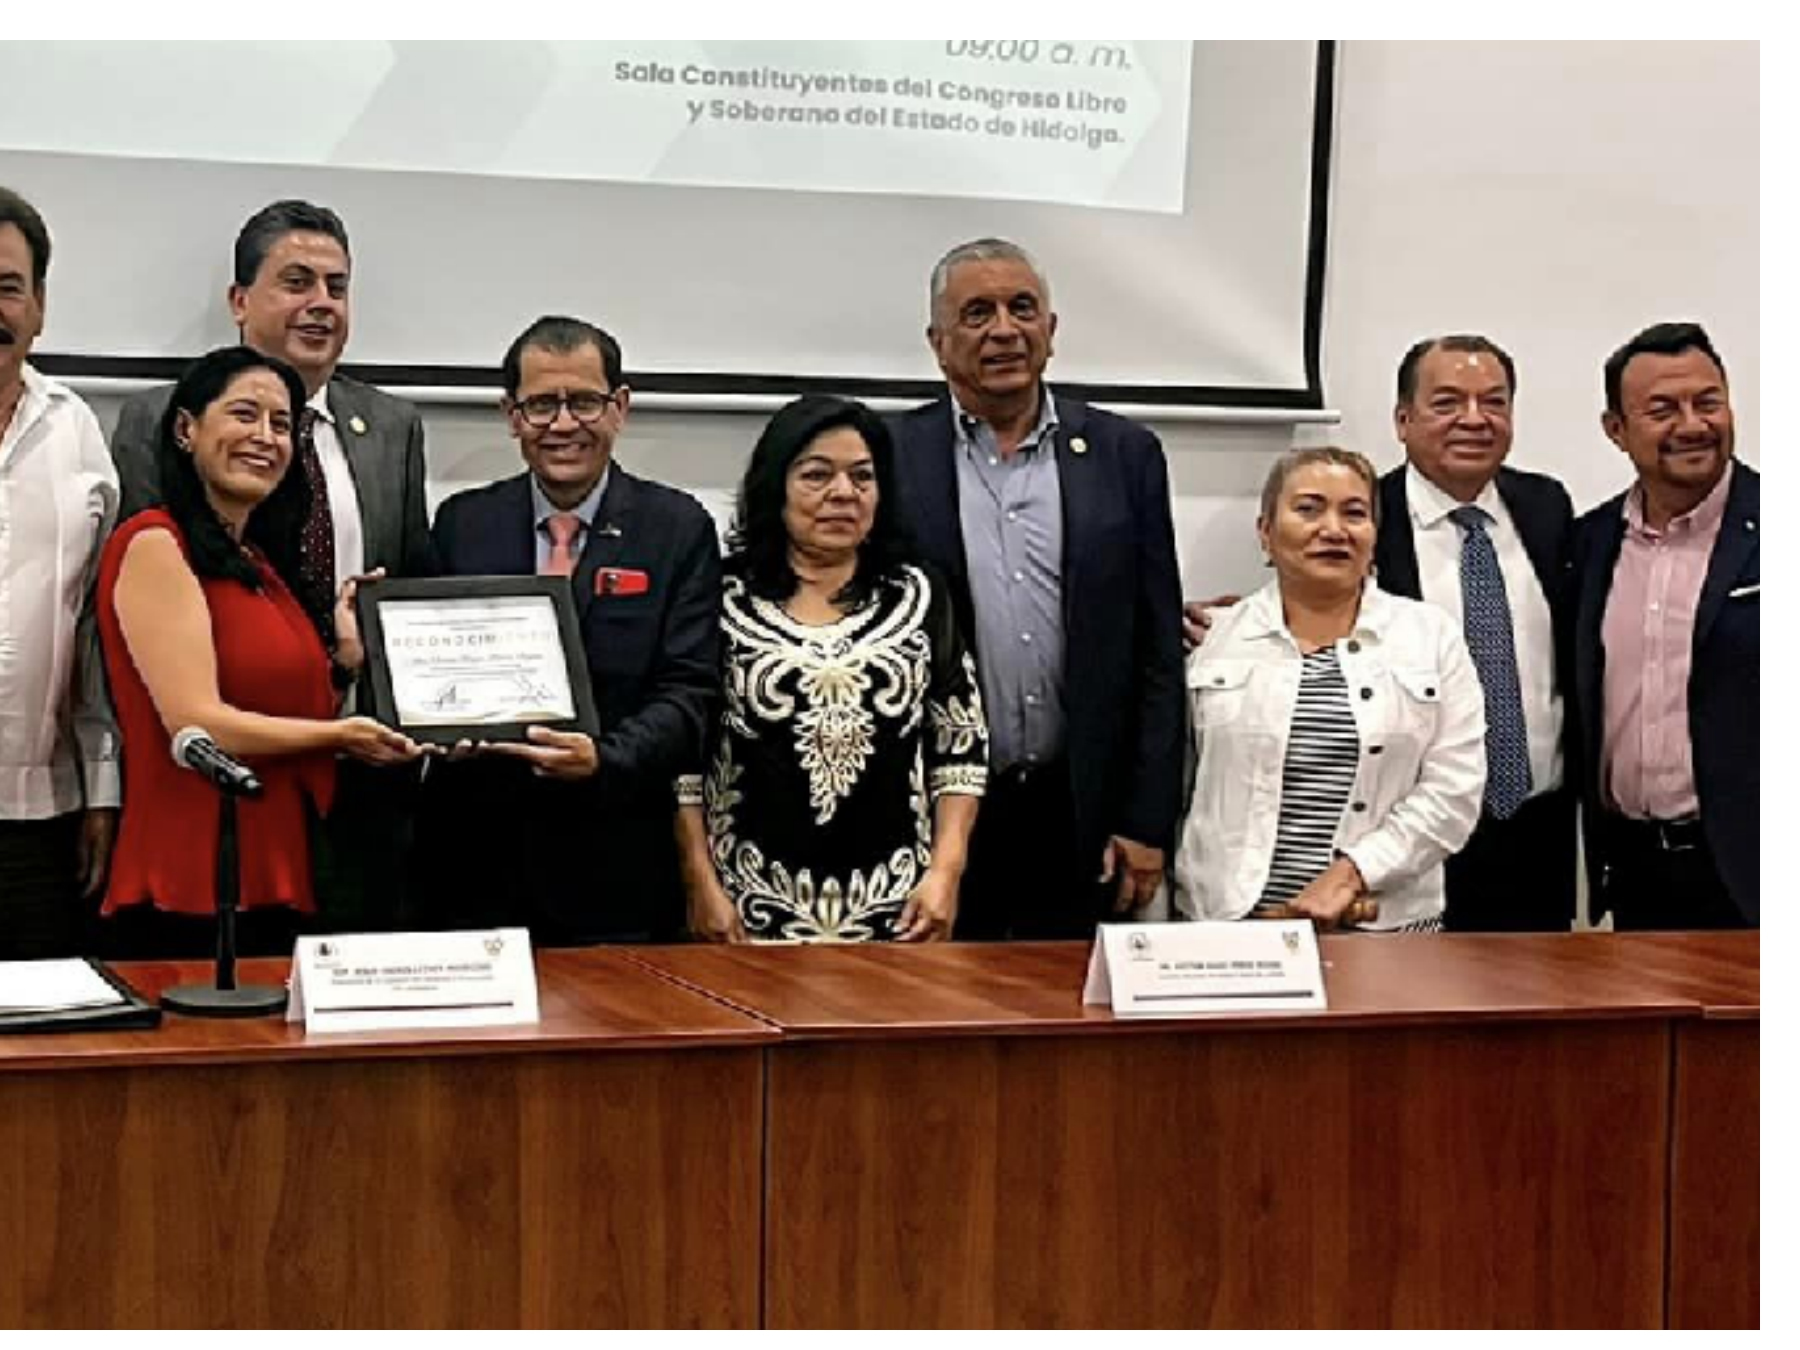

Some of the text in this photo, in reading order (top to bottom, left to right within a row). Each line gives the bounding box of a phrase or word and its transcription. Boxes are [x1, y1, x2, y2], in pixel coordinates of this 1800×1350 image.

[1088, 46, 1132, 71] m.
[615, 60, 1127, 114] Sala Constituyentes del Congreso Libre
[686, 100, 703, 124] y
[709, 100, 839, 124] Soberano
[844, 105, 887, 127] del
[893, 108, 979, 133] Estado
[986, 115, 1016, 136] de
